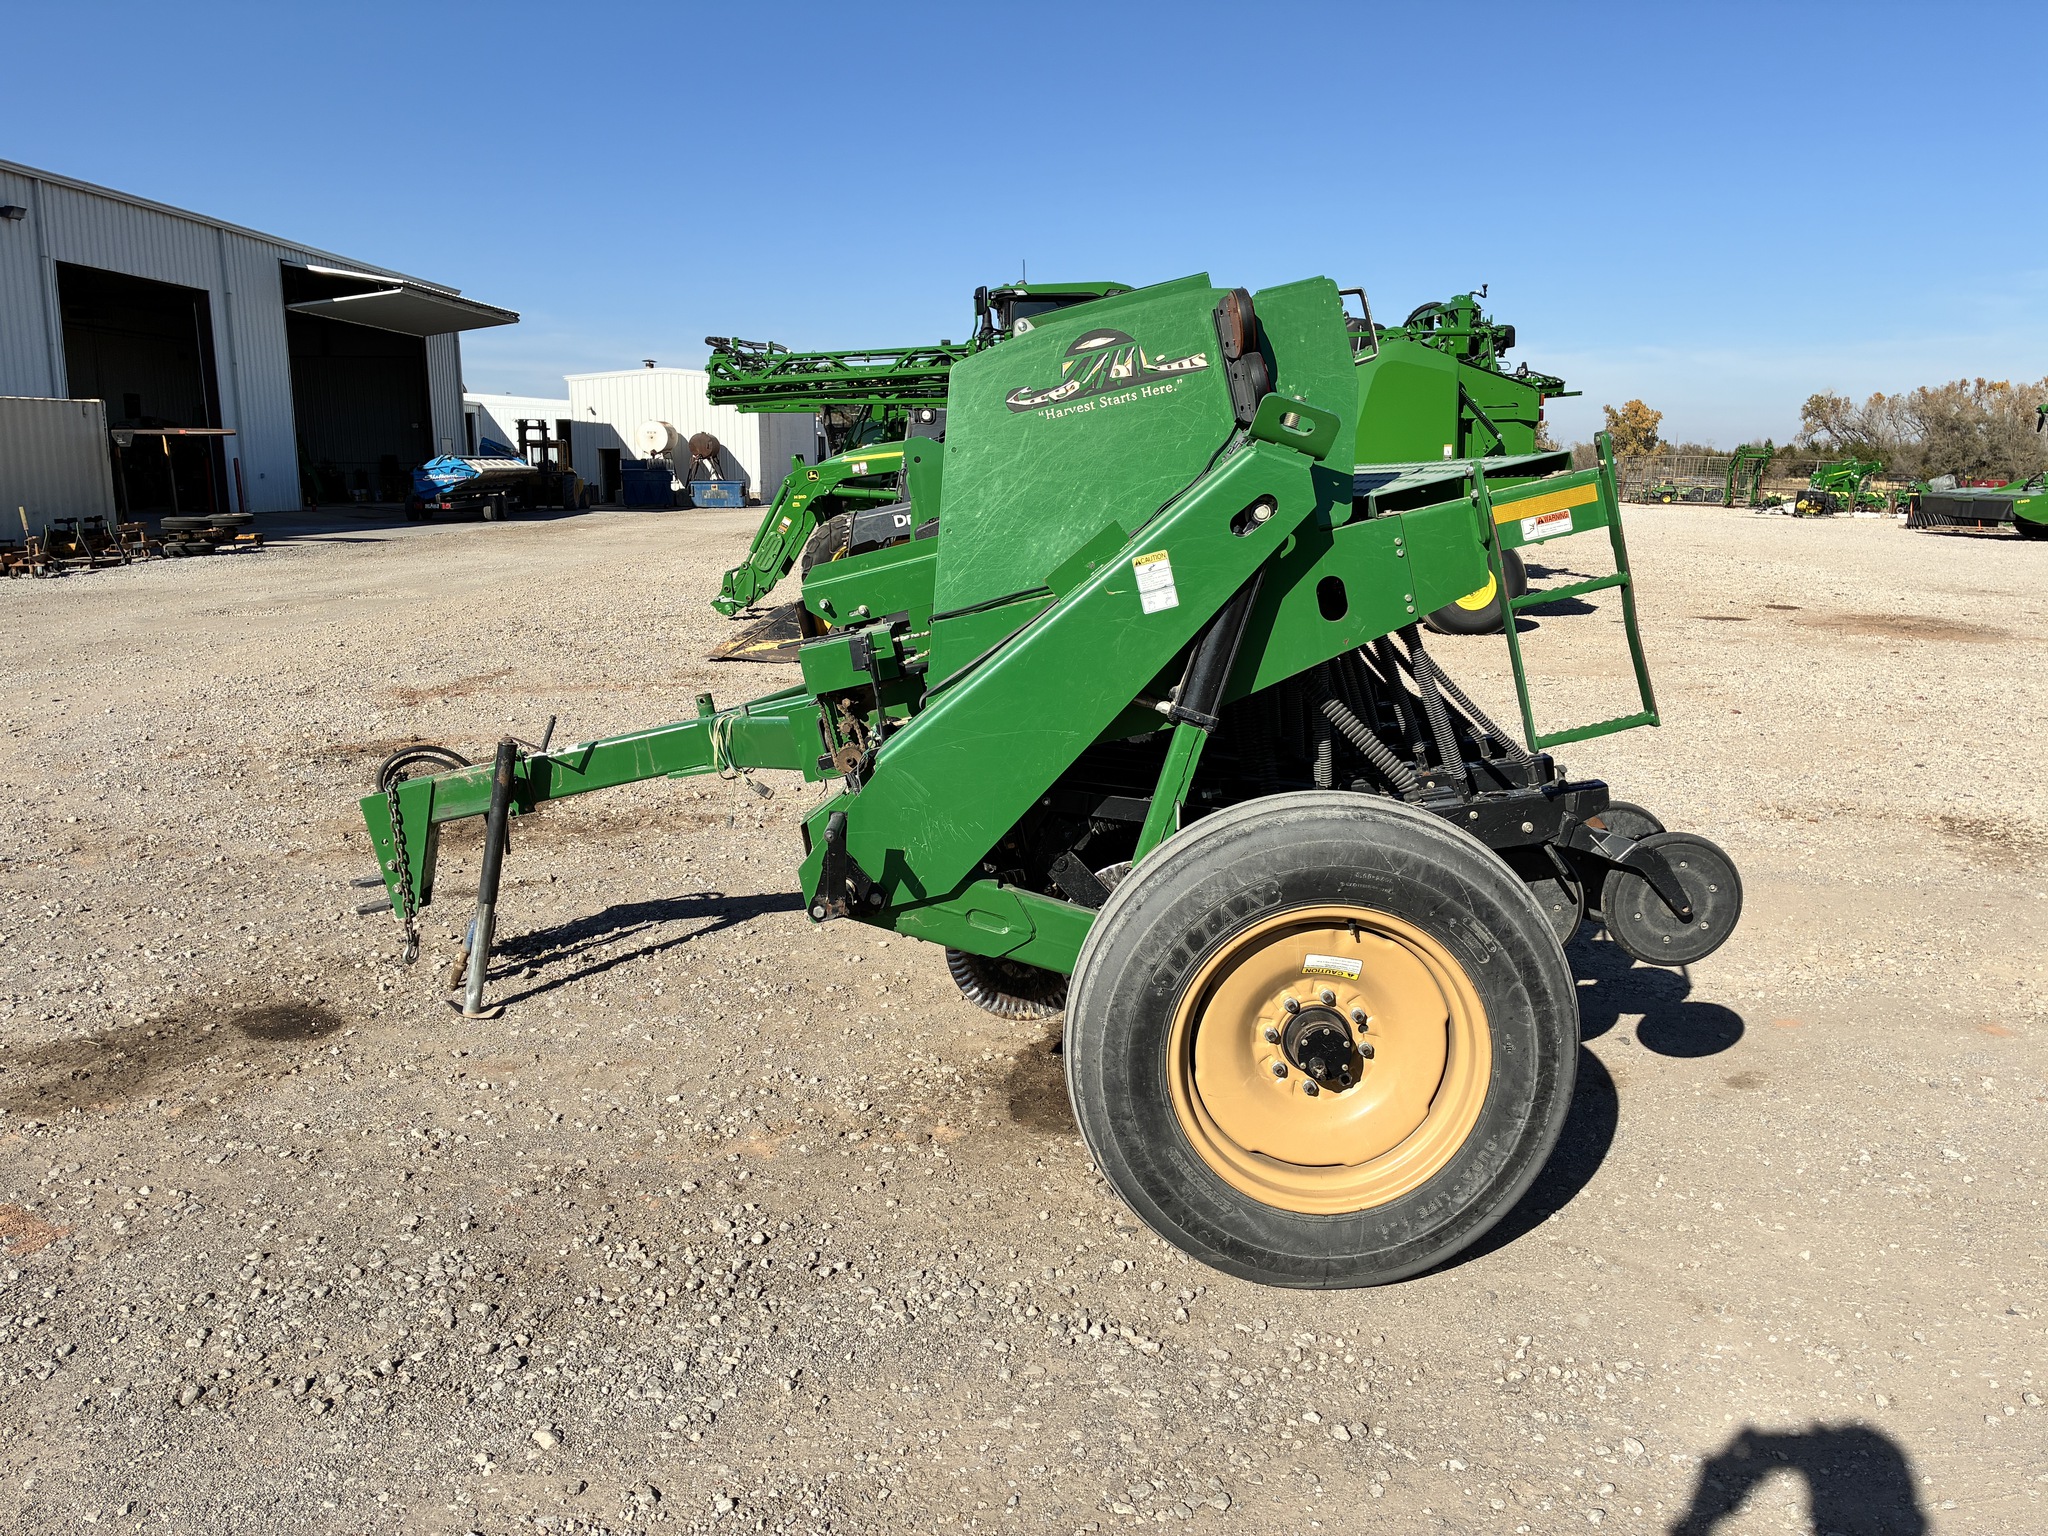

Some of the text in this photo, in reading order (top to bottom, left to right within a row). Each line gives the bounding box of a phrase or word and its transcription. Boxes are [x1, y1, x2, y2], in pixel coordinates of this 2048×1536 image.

[1099, 391, 1137, 408] Starts
[1545, 511, 1569, 522] WARNING
[1140, 552, 1166, 563] CAUTION
[1160, 884, 1267, 981] TITAN
[1305, 968, 1344, 976] CAUTION
